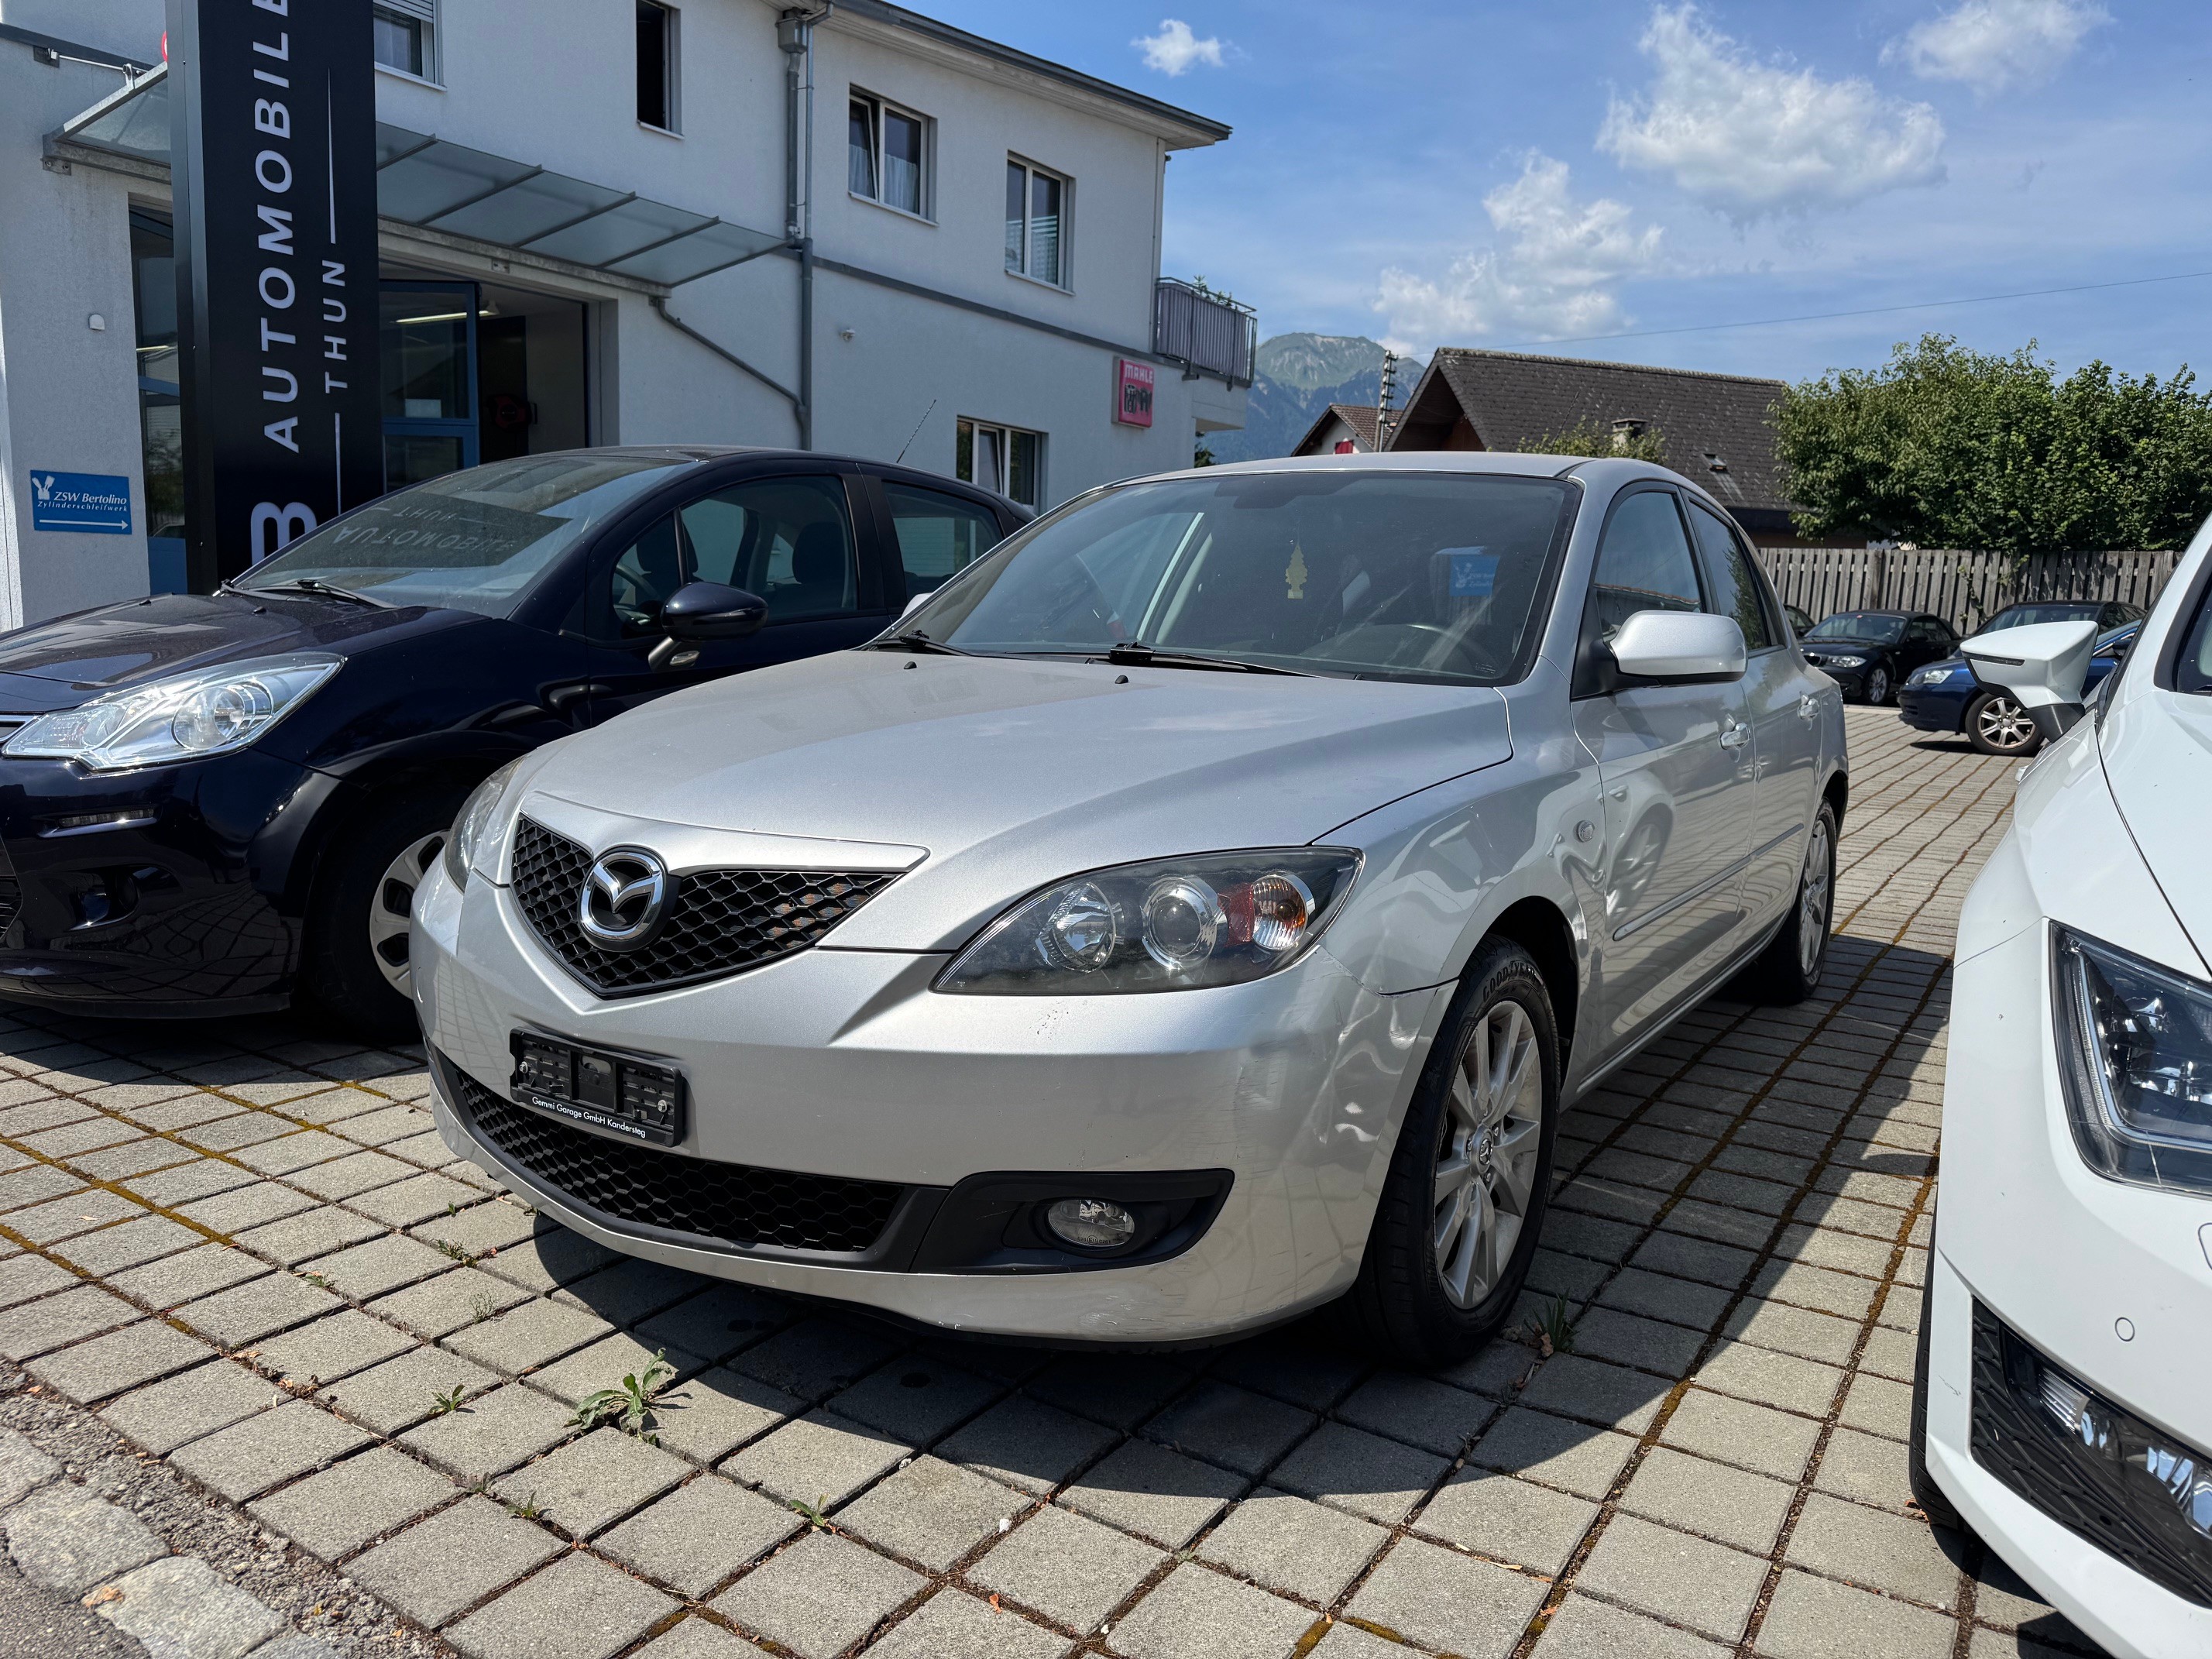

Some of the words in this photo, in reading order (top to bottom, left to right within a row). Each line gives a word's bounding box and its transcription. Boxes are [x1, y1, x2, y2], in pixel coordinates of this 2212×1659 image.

[322, 259, 349, 393] THUN
[1125, 364, 1152, 383] MAHLE
[37, 500, 127, 512] Zylinderschleifwerk
[53, 491, 80, 502] ZSW
[82, 493, 127, 505] Bertolino
[532, 1096, 555, 1110] Gemmi
[556, 1104, 582, 1118] Garage
[583, 1111, 606, 1125] GmbH
[607, 1118, 646, 1139] Kandersteg
